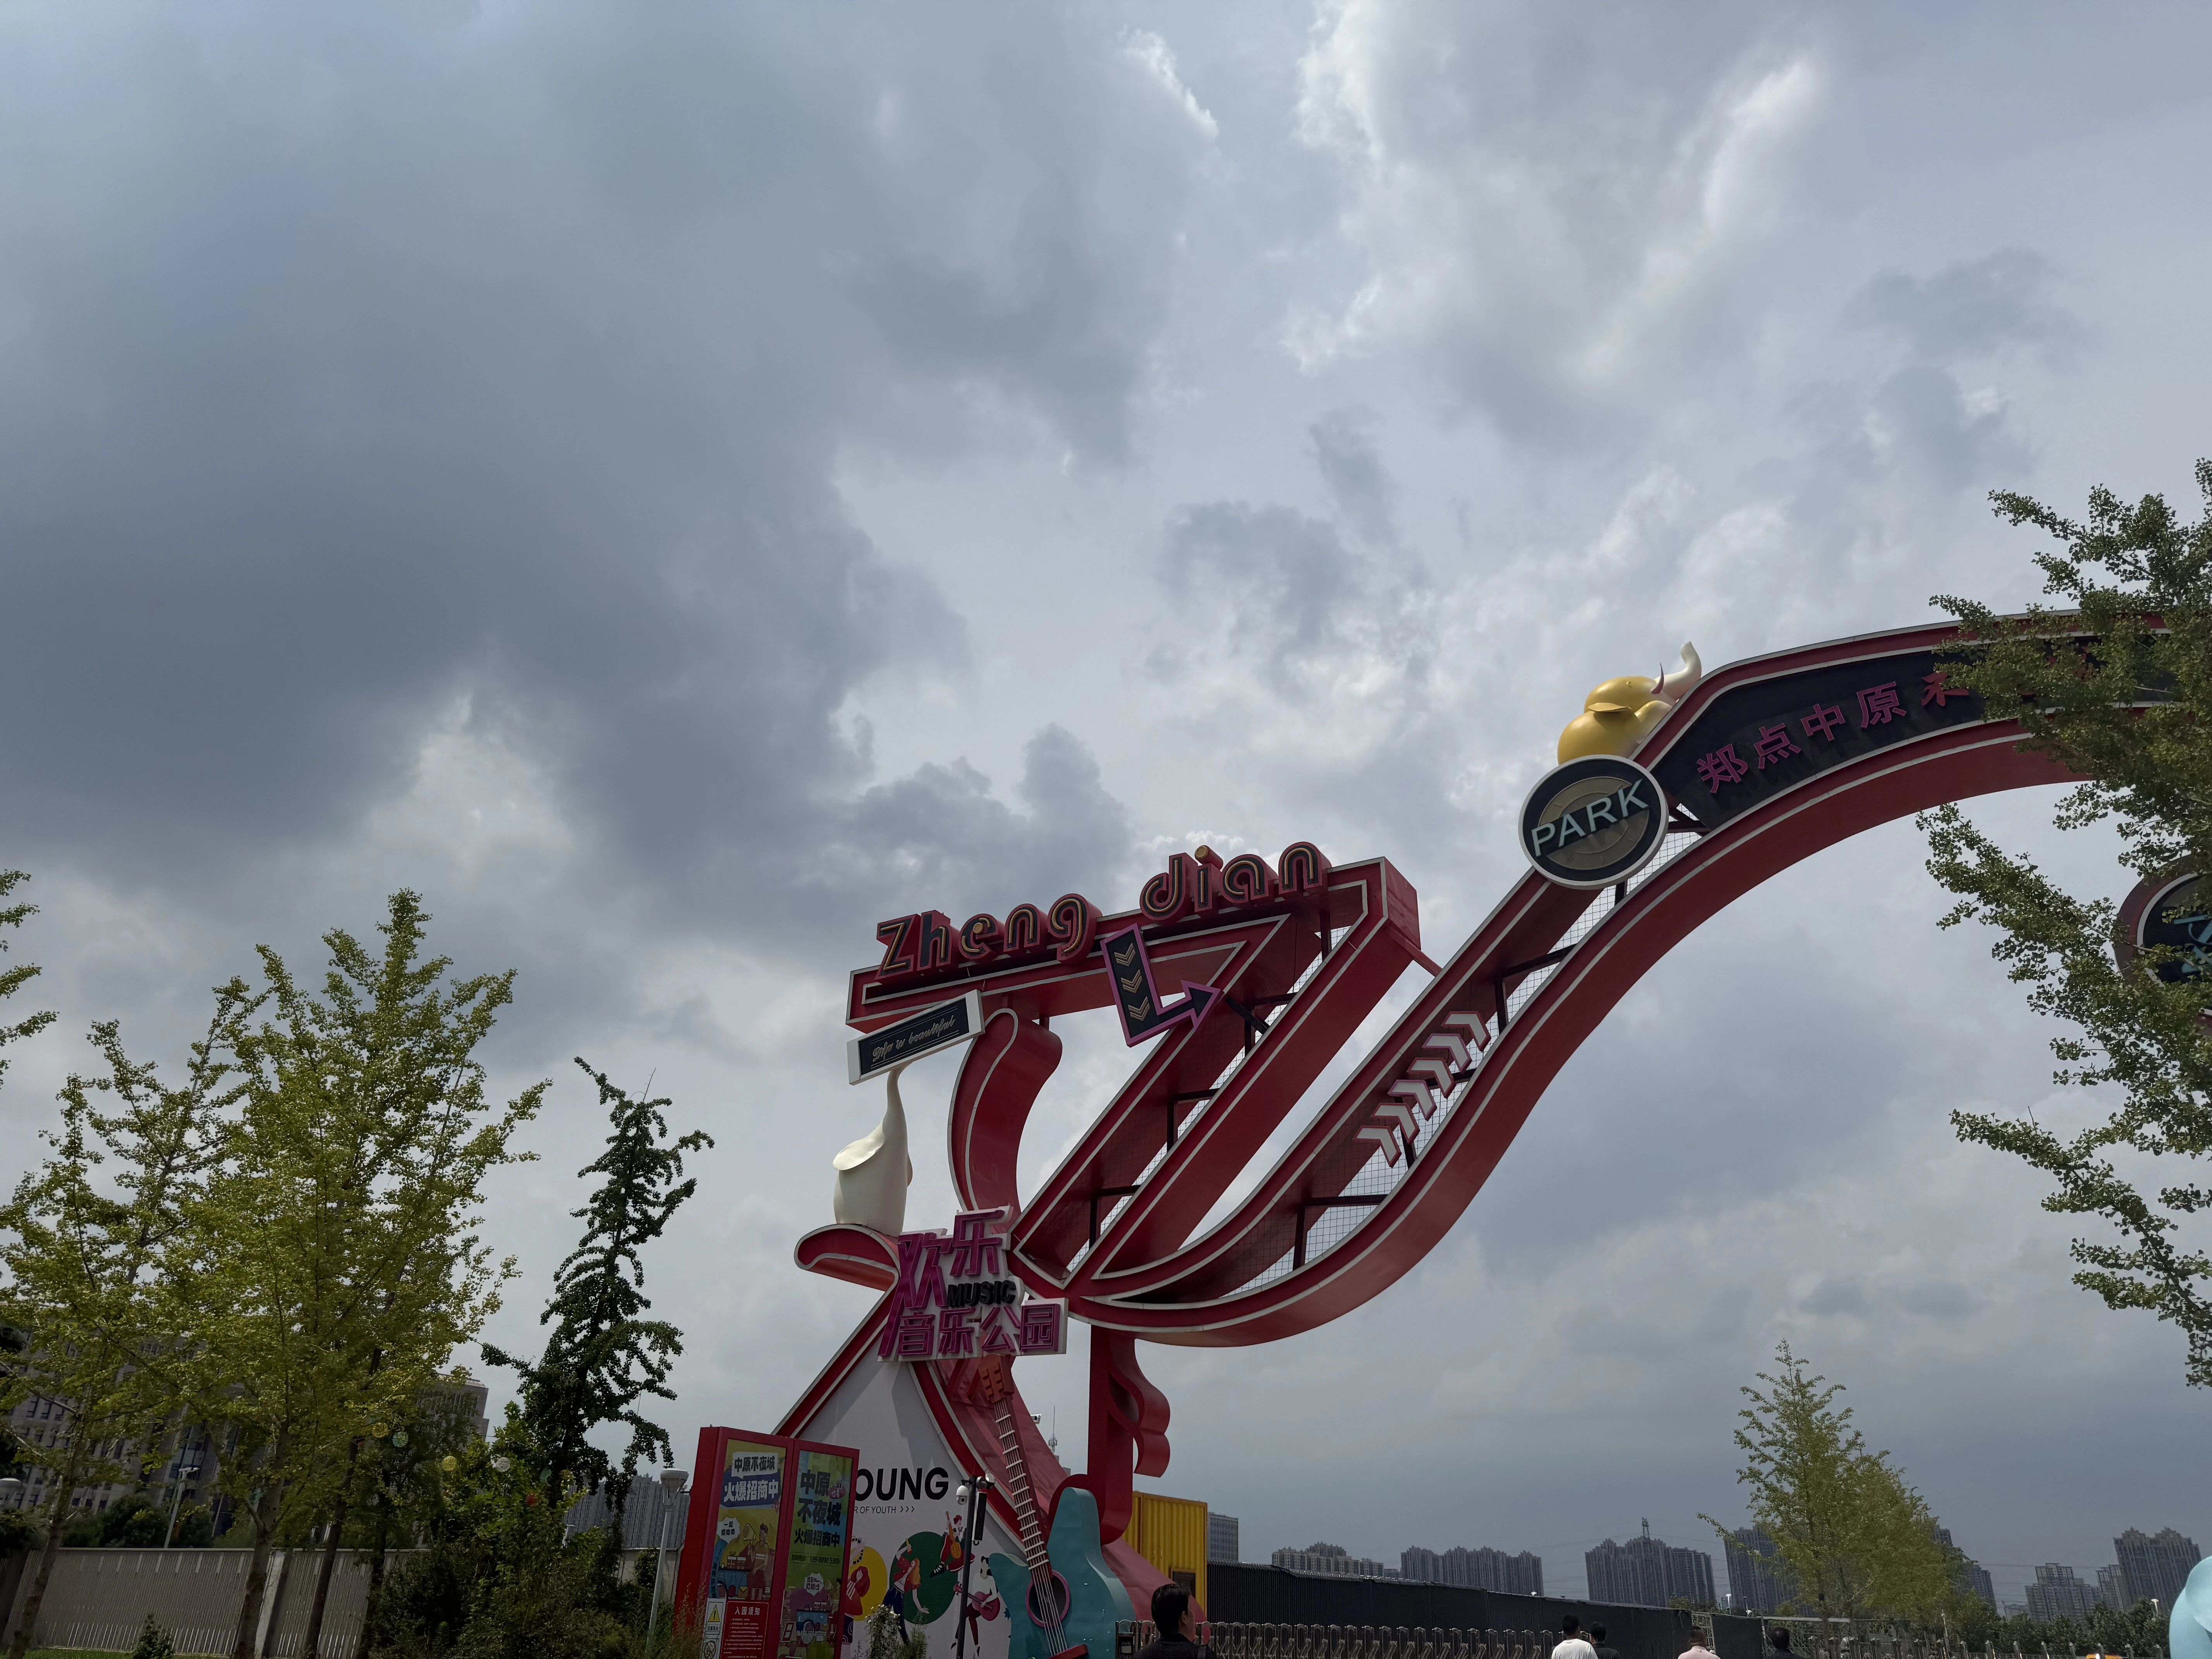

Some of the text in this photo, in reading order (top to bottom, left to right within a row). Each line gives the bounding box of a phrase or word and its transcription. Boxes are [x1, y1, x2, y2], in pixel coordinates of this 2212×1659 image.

[1531, 778, 1649, 857] PARK
[875, 842, 1324, 980] Zheng dian
[896, 1039, 905, 1049] is
[908, 1015, 955, 1044] beautiful
[878, 1210, 1005, 1356] 欢乐
[947, 1279, 1016, 1308] MUSIC
[897, 1303, 1060, 1355] 音乐公园
[734, 1456, 775, 1472] 中原不夜城
[724, 1479, 779, 1503] 火爆招商中
[800, 1469, 831, 1496] 中原
[797, 1498, 842, 1526] 不夜城
[794, 1528, 840, 1547] 火爆招商中
